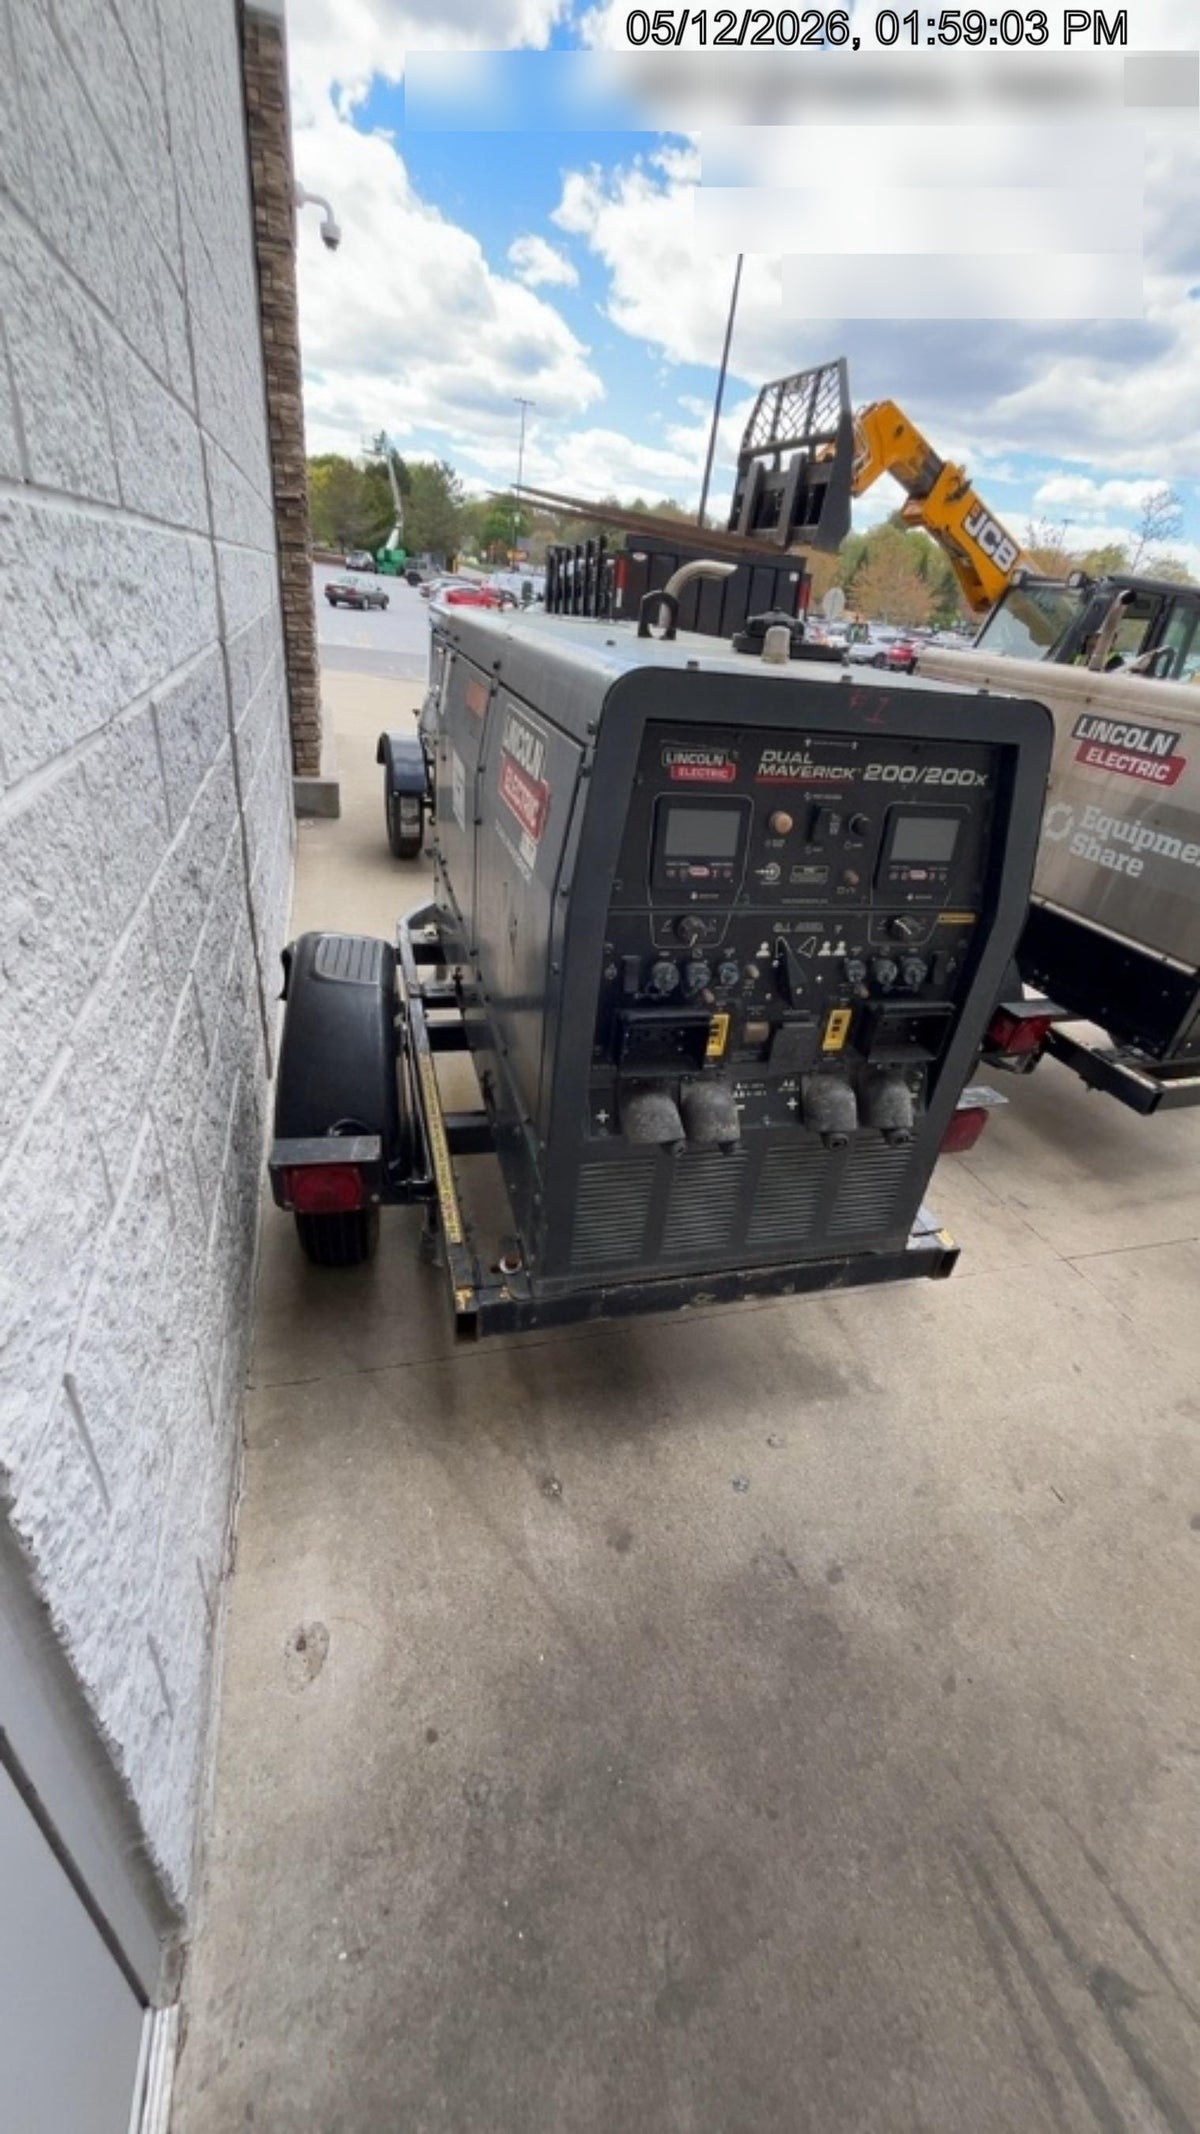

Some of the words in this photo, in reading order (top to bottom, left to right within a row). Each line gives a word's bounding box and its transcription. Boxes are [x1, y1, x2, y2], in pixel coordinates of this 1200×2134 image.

[964, 512, 1018, 572] JCB
[1076, 717, 1173, 755] LINCOLN
[664, 751, 726, 766] LINCOLN
[676, 766, 729, 779] ELECTRIC
[757, 762, 854, 780] MAVERICK
[760, 750, 813, 764] DUAL
[1086, 748, 1170, 780] ELECTRIC
[1080, 805, 1200, 870] Equipme
[1069, 832, 1144, 878] Share
